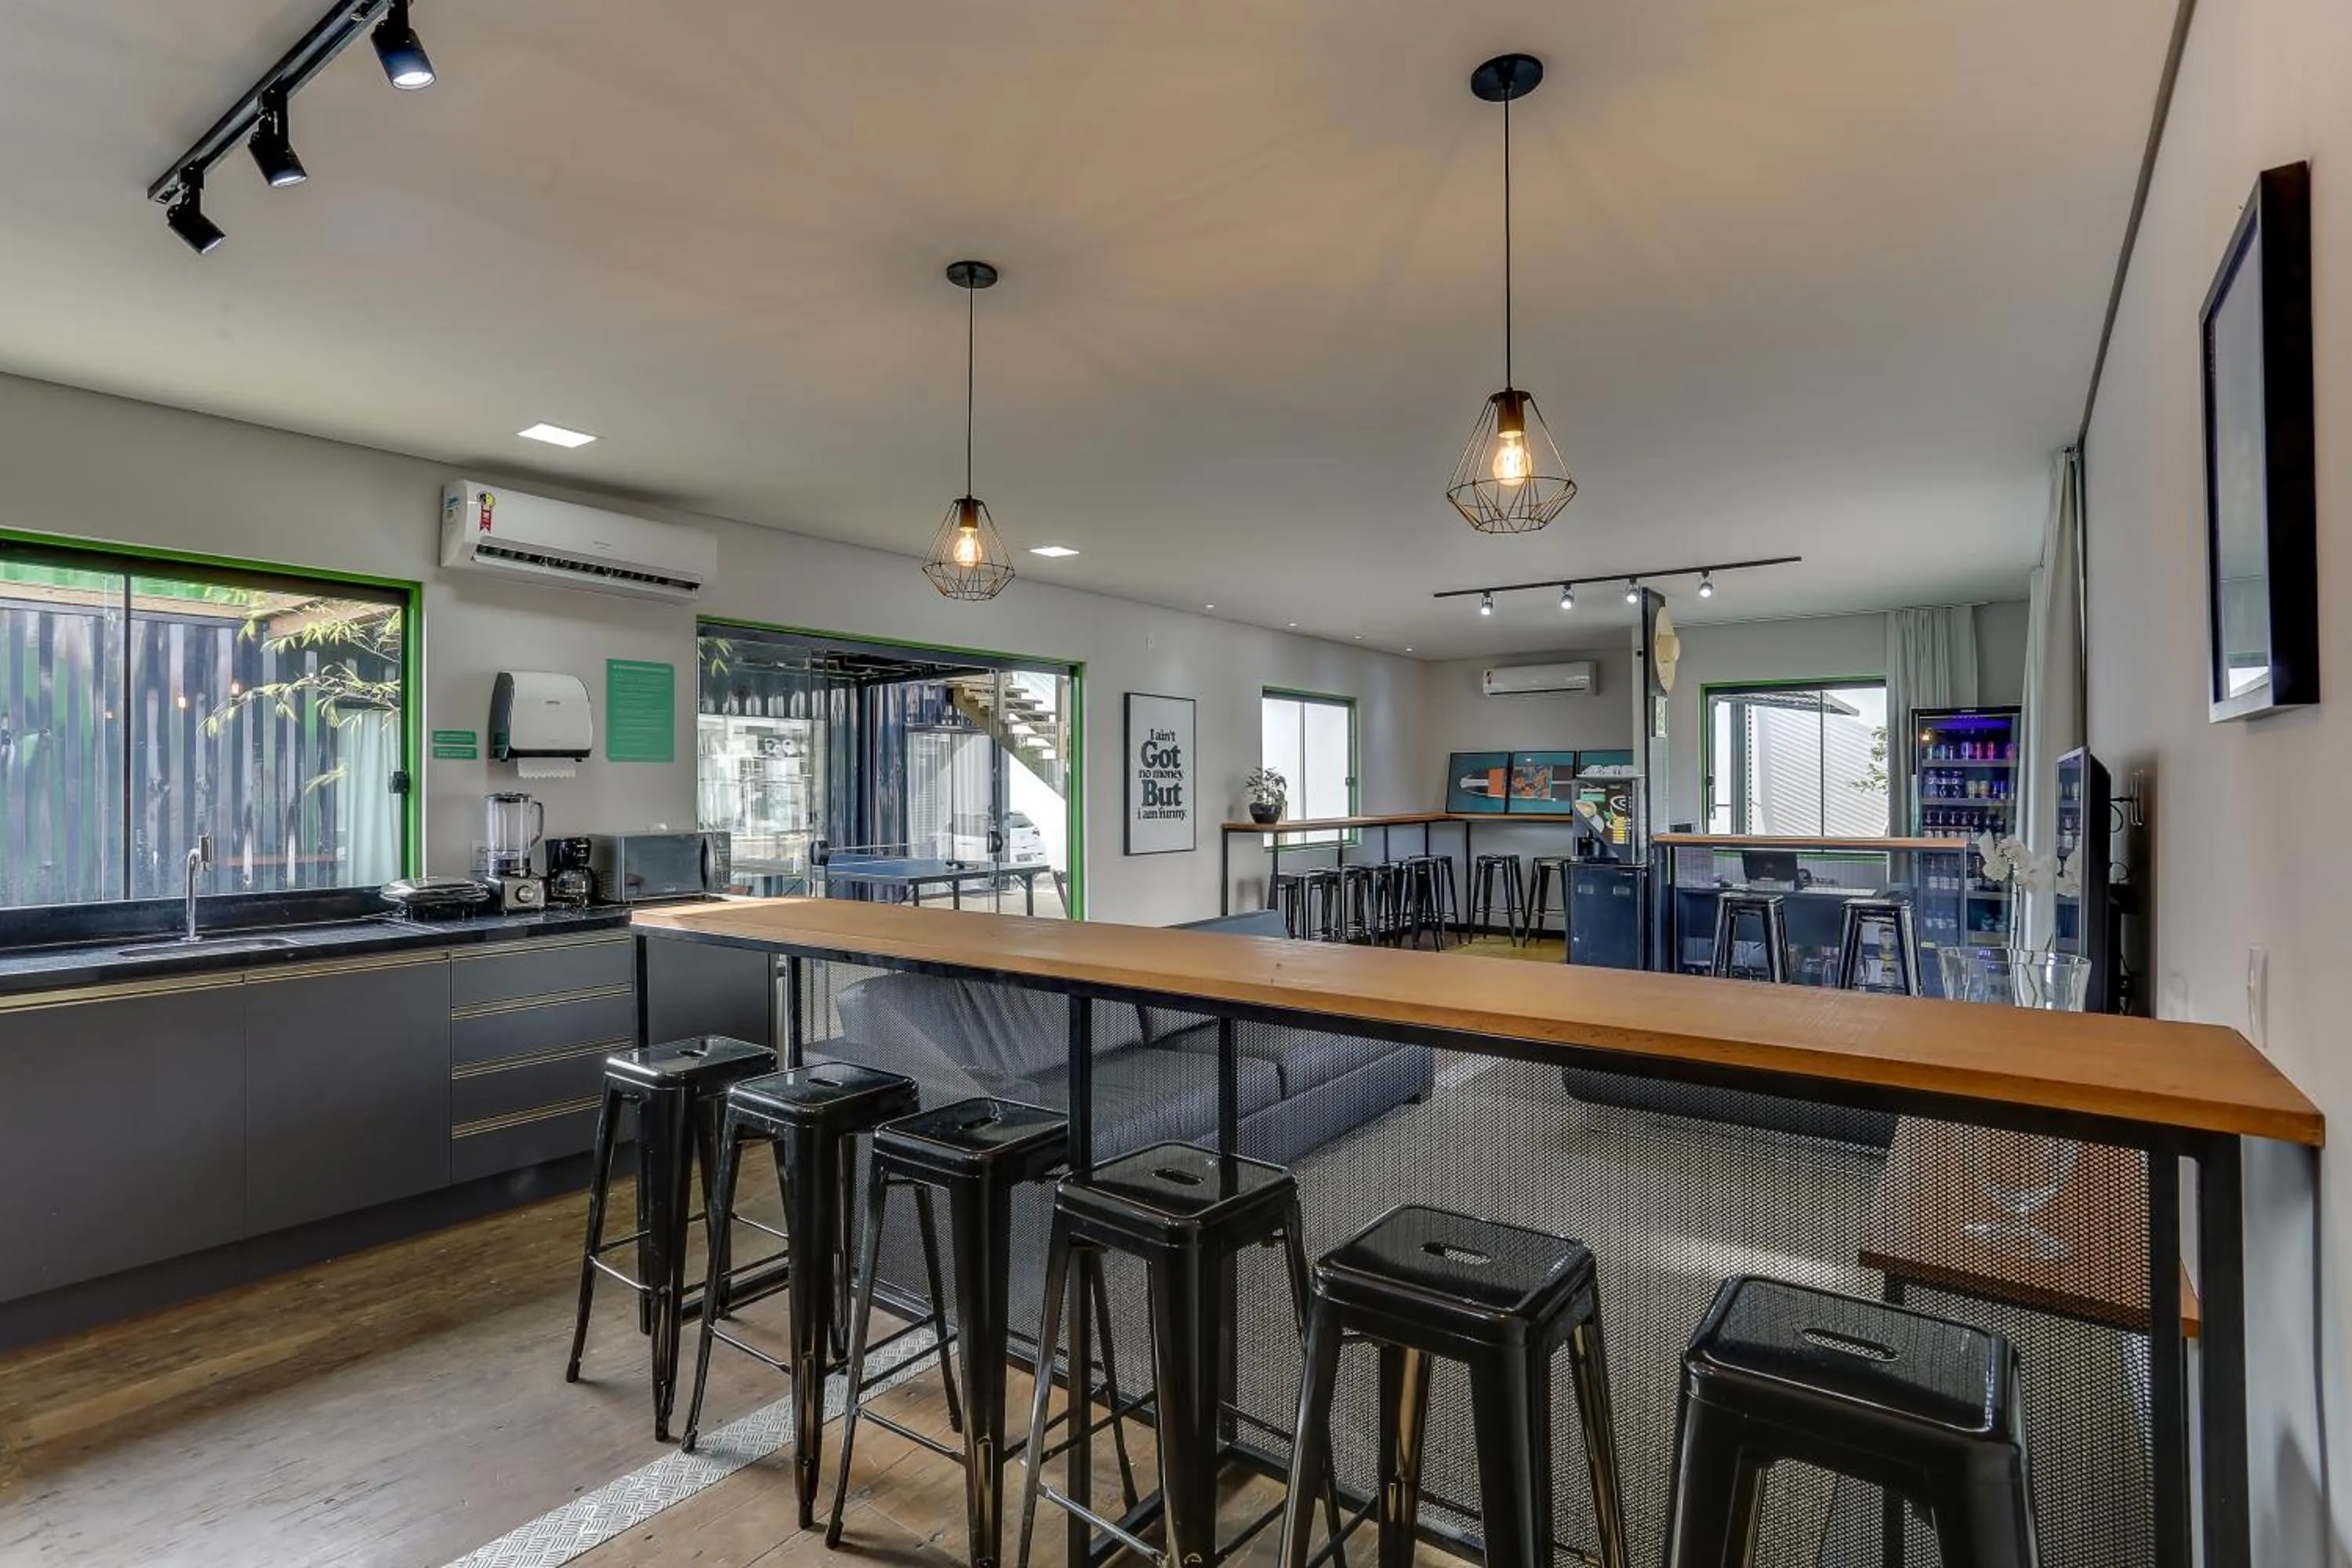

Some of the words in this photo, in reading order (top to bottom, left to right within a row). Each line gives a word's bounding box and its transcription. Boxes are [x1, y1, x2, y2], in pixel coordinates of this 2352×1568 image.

[1150, 728, 1155, 741] I
[1156, 728, 1176, 742] ain't
[1141, 740, 1181, 768] Got
[1139, 769, 1152, 779] no
[1152, 769, 1184, 782] money
[1142, 779, 1183, 807] But
[1142, 810, 1158, 819] am
